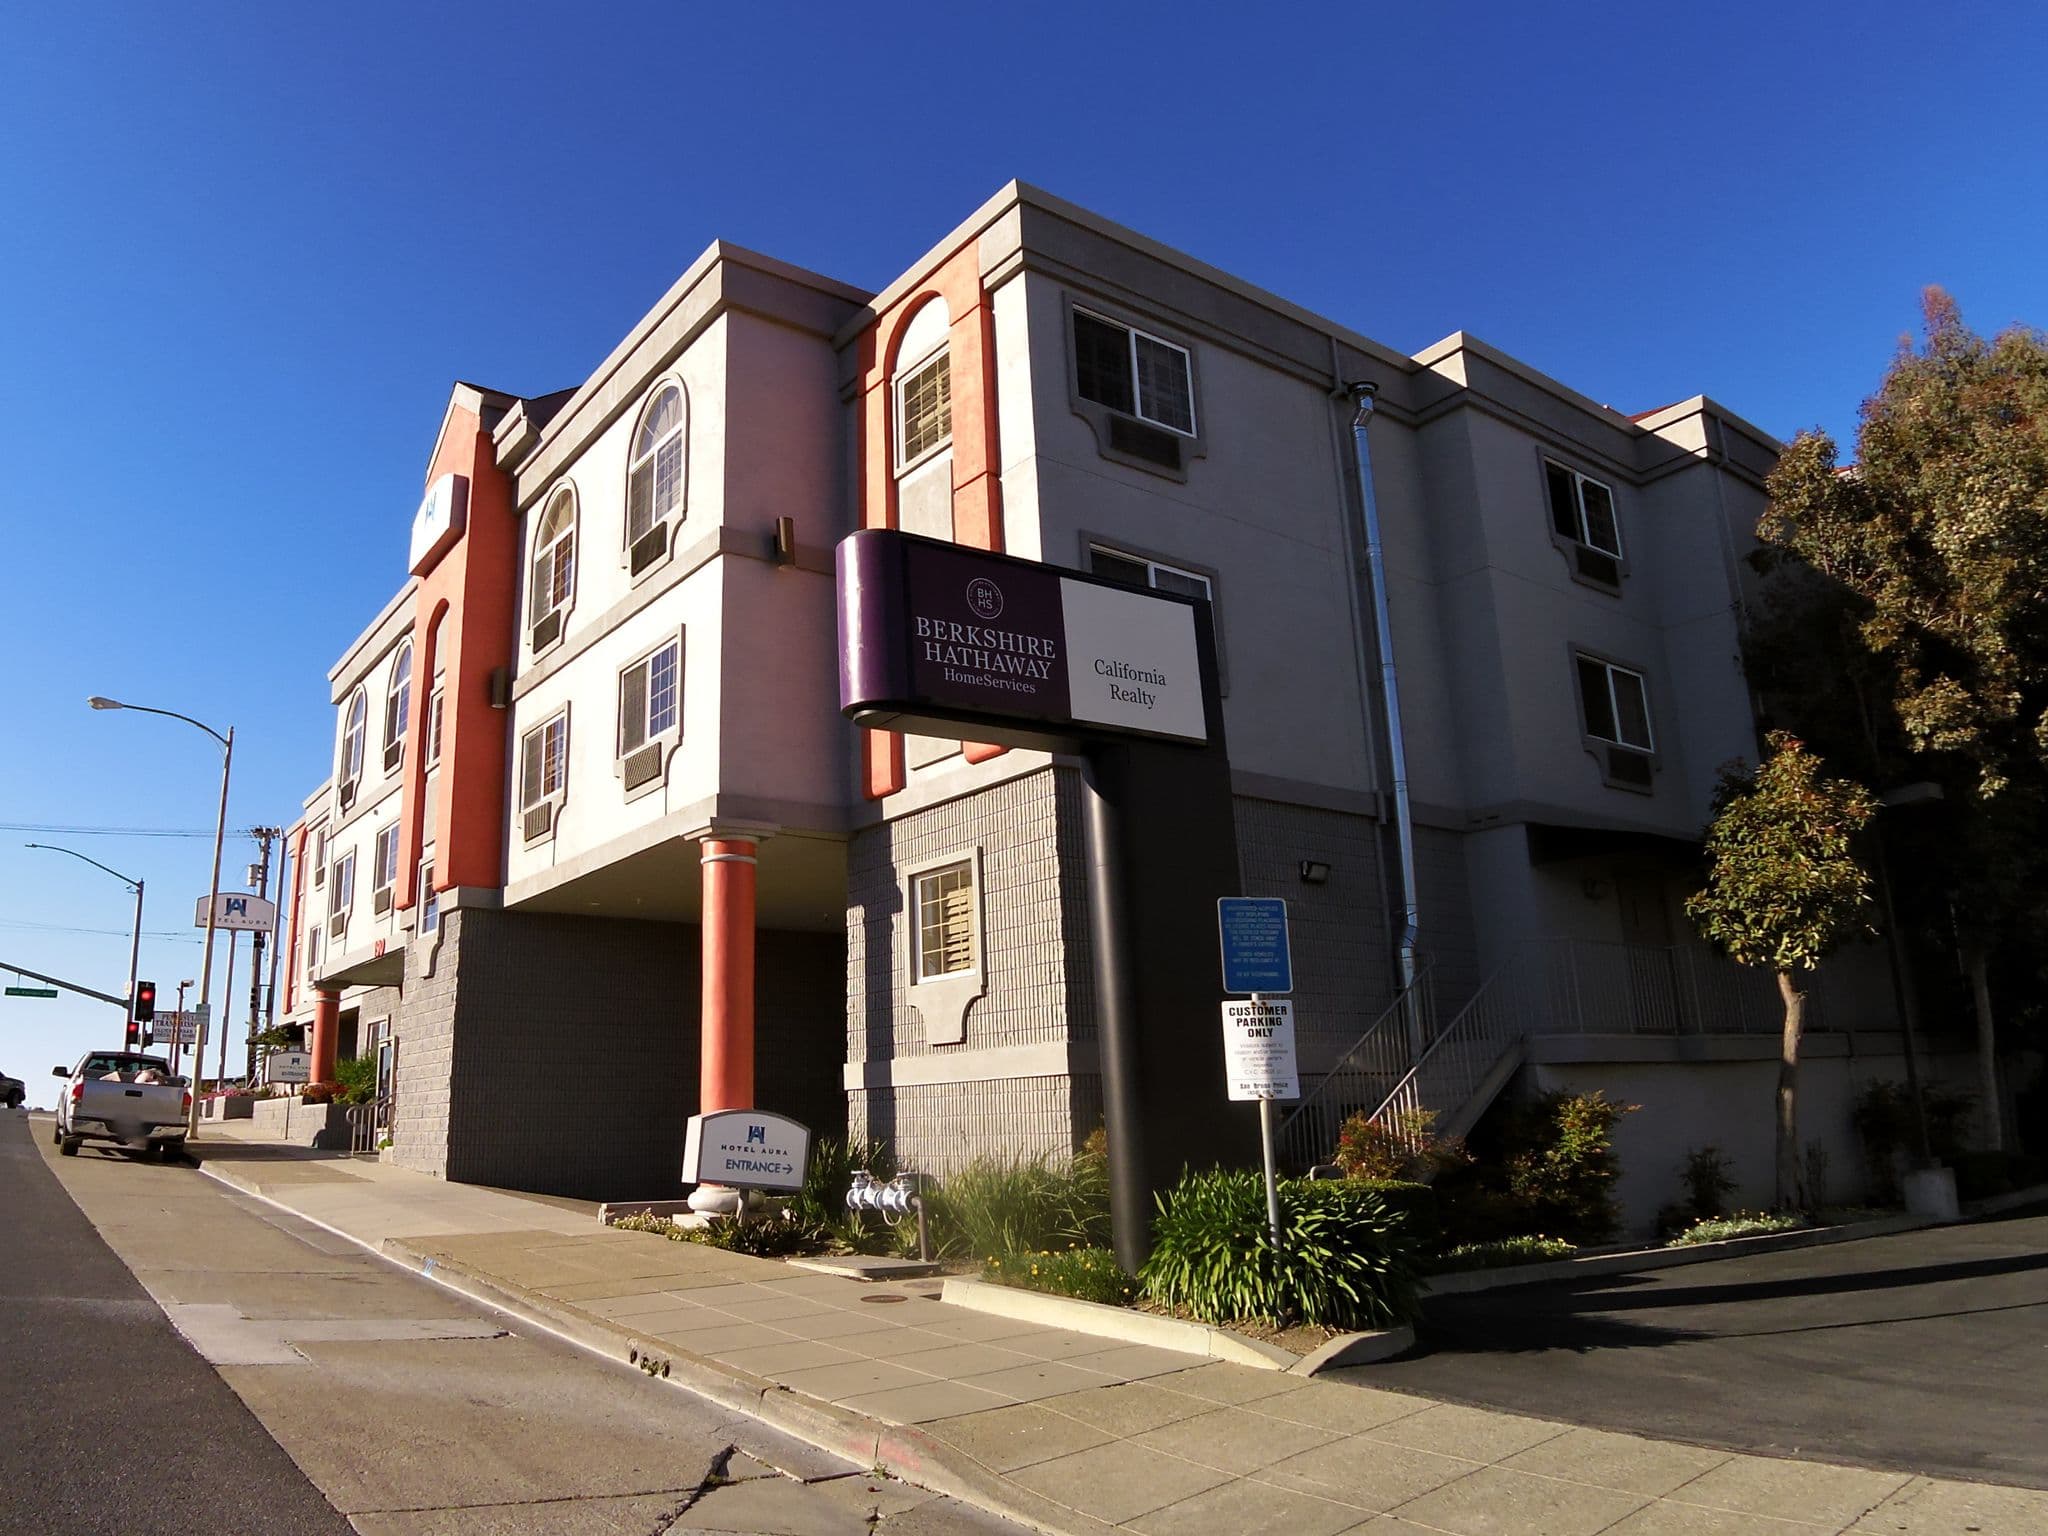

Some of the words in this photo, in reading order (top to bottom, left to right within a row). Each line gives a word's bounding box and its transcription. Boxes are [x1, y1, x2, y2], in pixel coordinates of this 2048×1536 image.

[977, 587, 993, 599] BH
[978, 598, 993, 610] HS
[915, 616, 1056, 659] BERKSHIRE
[924, 641, 1052, 680] HATHAWAY
[1094, 659, 1166, 686] California
[944, 667, 1036, 693] HomeServices
[1109, 683, 1156, 710] Realty
[1229, 1006, 1287, 1016] CUSTOMER
[1236, 1017, 1282, 1027] PARKING
[1248, 1028, 1273, 1037] ONLY
[721, 1144, 755, 1153] HOTEL
[761, 1148, 788, 1156] AURA
[726, 1159, 781, 1174] ENTRANCE
